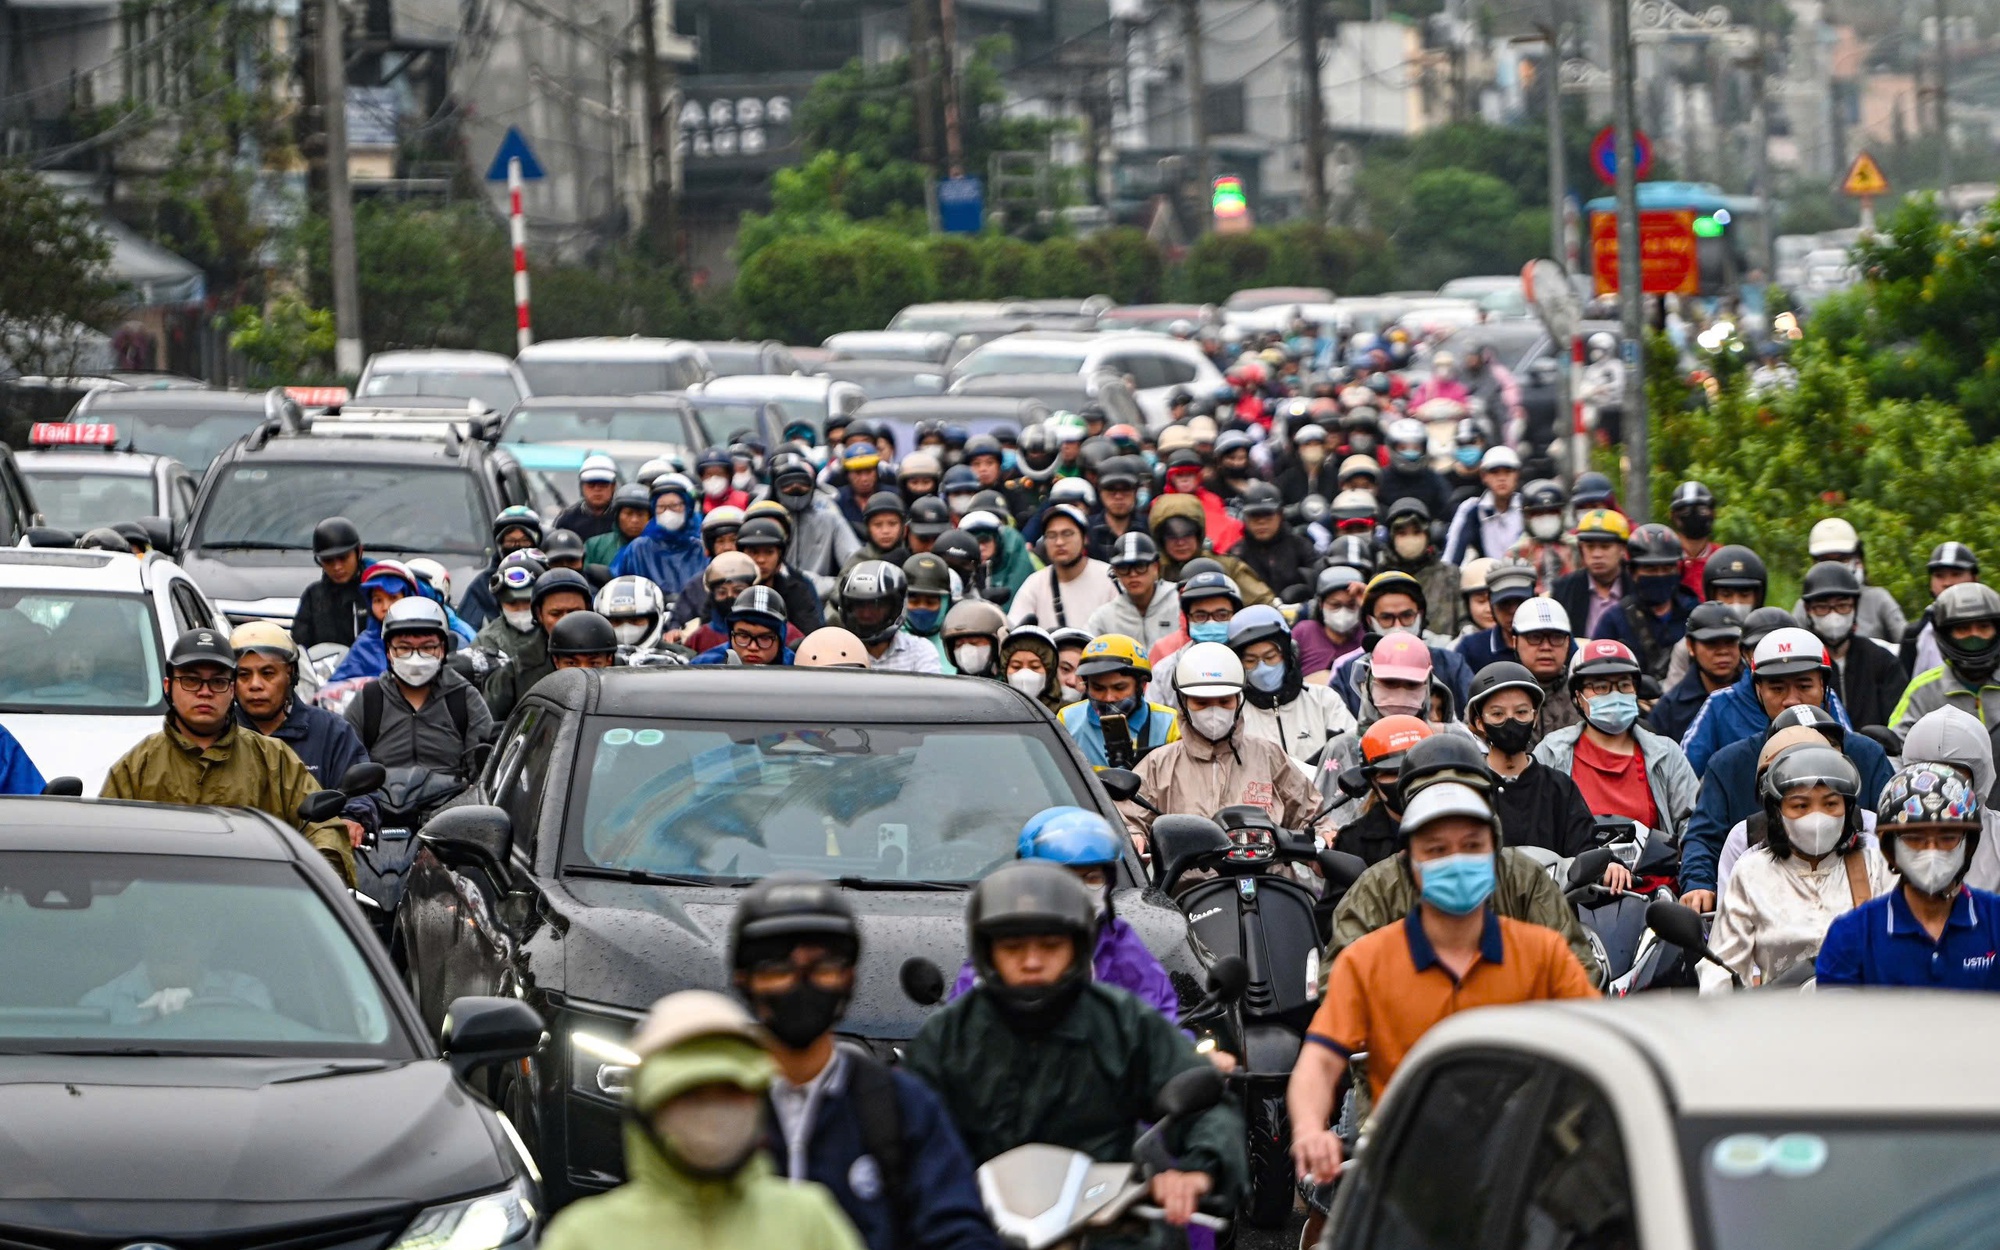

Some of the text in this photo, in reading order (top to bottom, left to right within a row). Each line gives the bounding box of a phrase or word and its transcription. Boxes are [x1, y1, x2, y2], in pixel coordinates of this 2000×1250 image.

[38, 423, 110, 442] Taxi 123
[1188, 907, 1223, 923] Vespa
[1963, 955, 1991, 967] USTH
